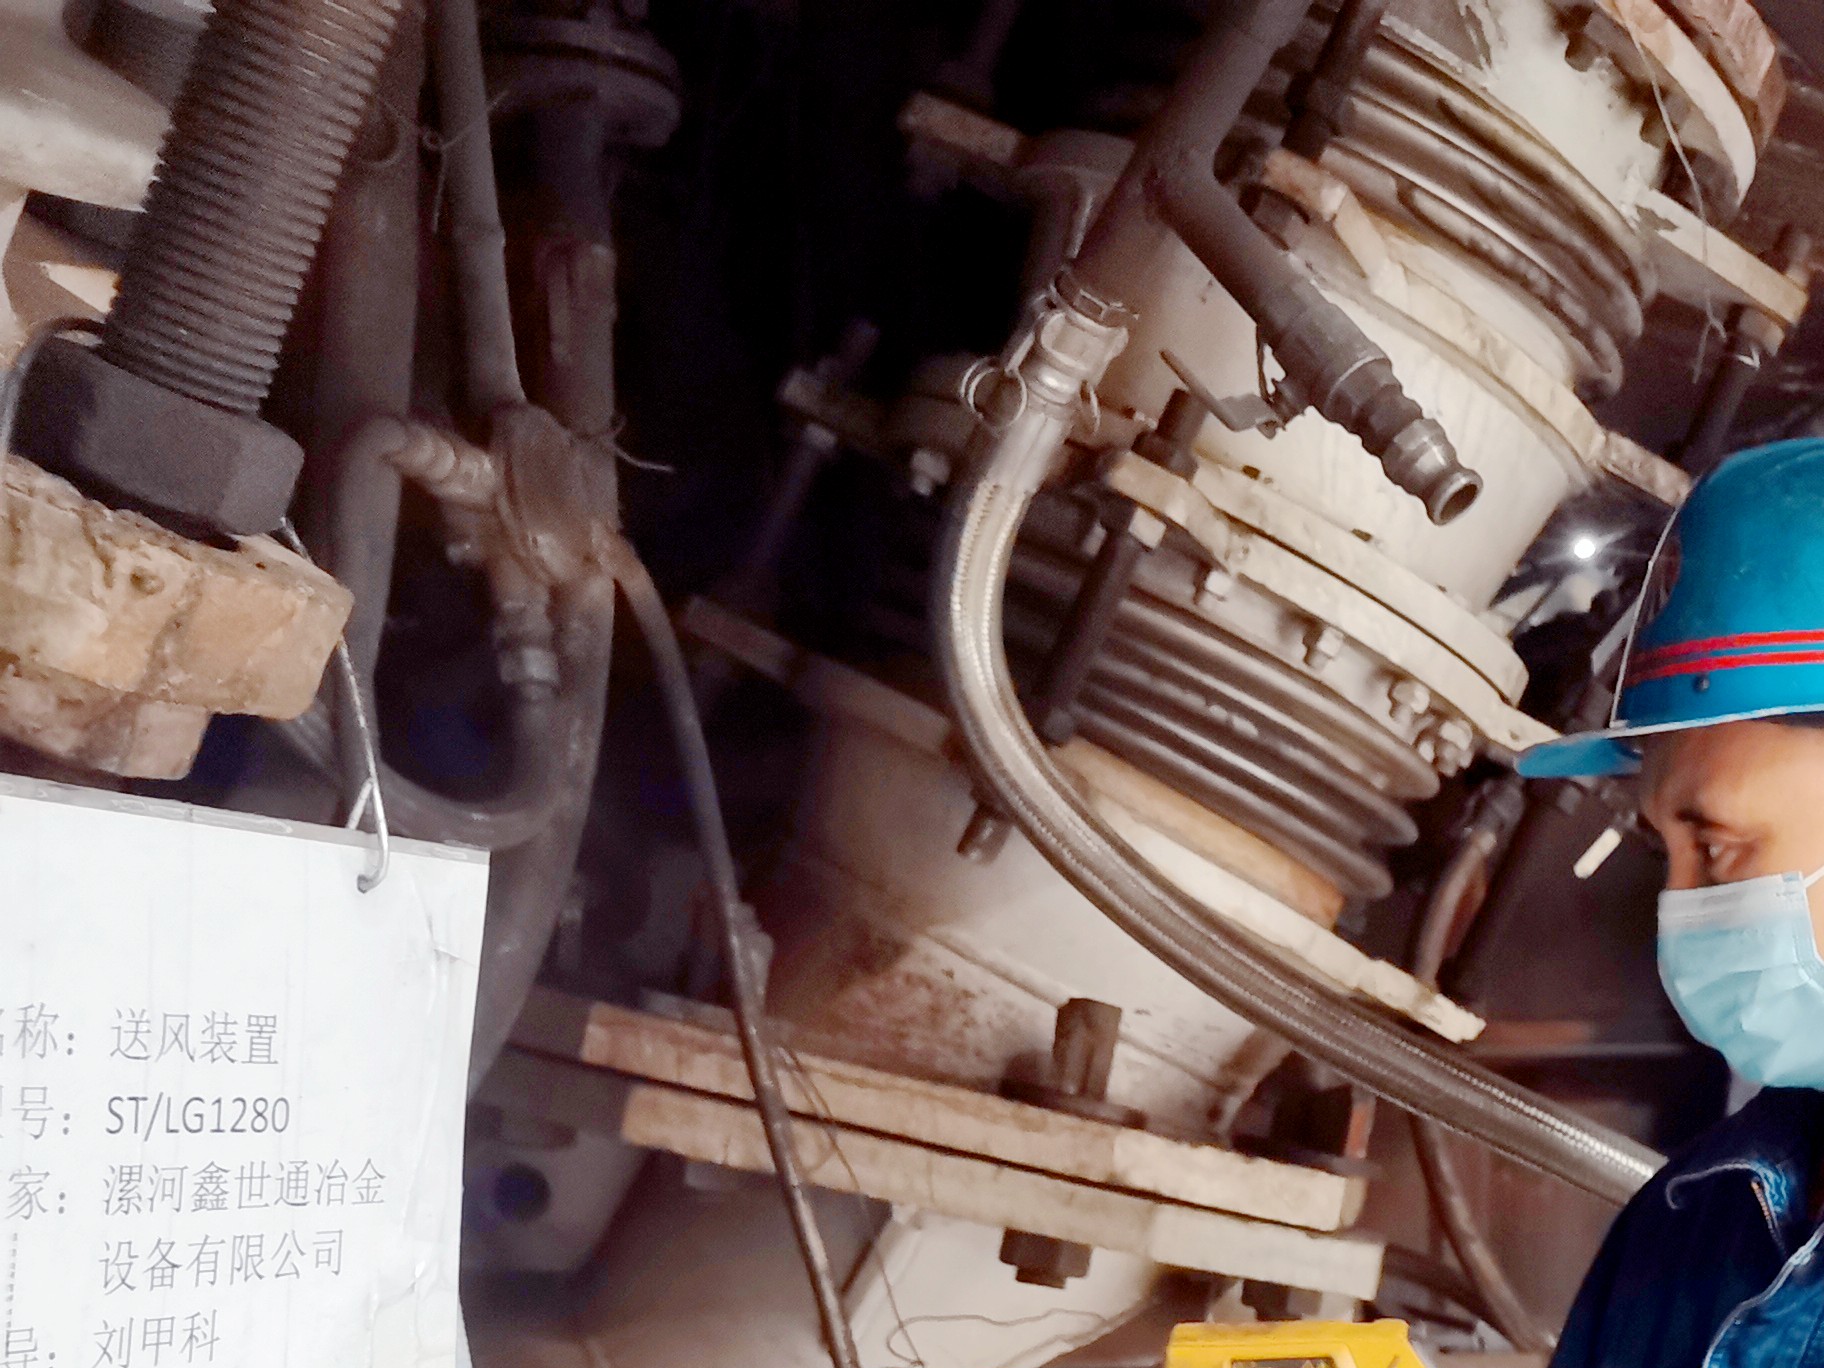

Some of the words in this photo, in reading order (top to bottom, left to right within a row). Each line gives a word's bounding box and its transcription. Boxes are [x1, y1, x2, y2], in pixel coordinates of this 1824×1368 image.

[0, 1003, 75, 1060] 称：
[109, 1008, 279, 1065] 送风装置
[0, 1086, 71, 1142] 号：
[105, 1092, 291, 1143] ST/LG1280
[102, 1157, 386, 1217] 漯河鑫世通冶金
[99, 1229, 345, 1295] 设备有限公司
